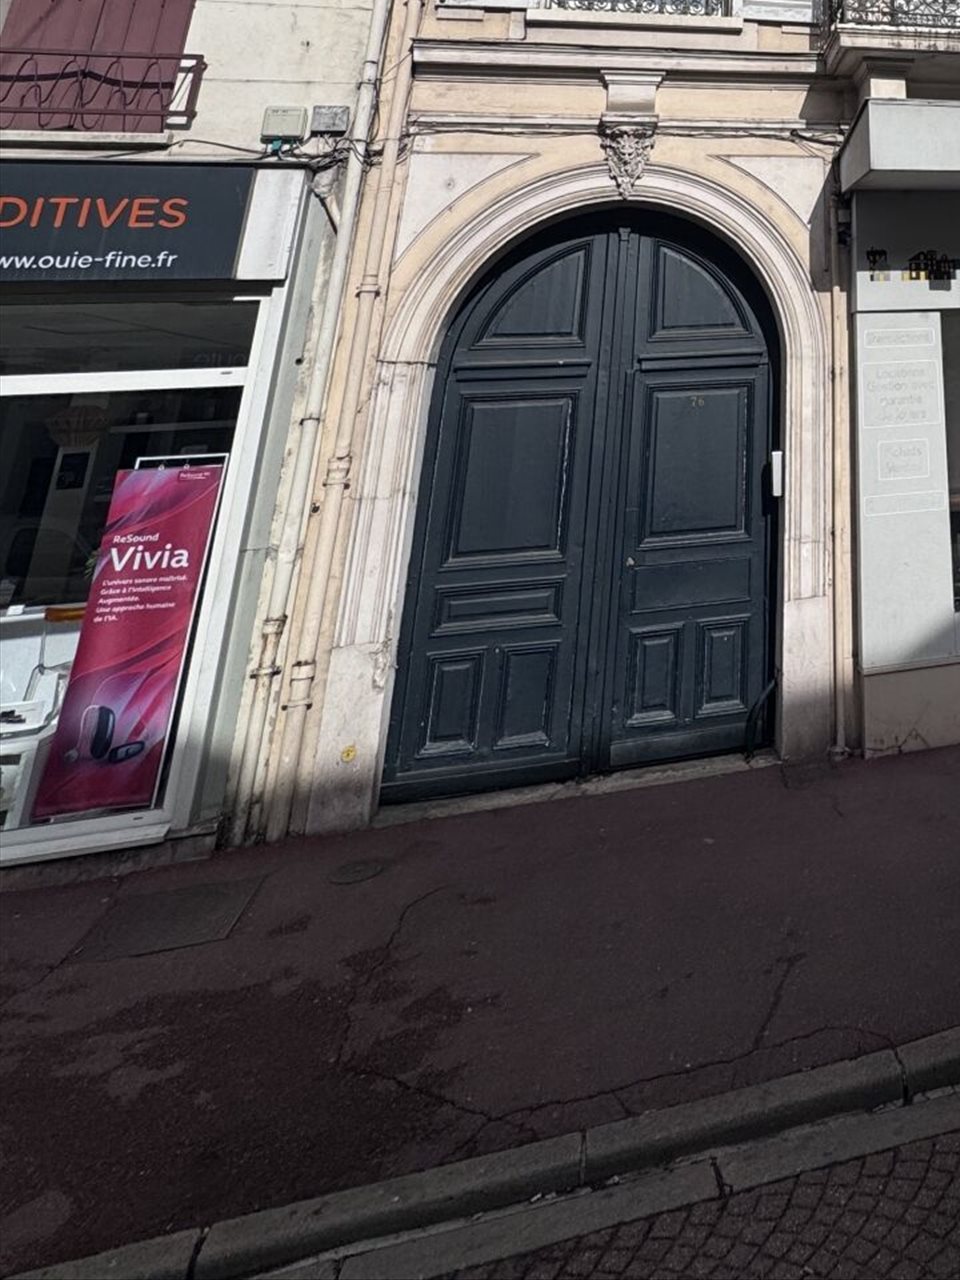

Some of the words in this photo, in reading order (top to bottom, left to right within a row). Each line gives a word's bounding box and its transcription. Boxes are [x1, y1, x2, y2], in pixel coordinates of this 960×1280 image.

[113, 532, 160, 544] ReSound
[110, 543, 190, 572] Vivia
[112, 603, 145, 613] approche
[146, 602, 176, 610] humaine
